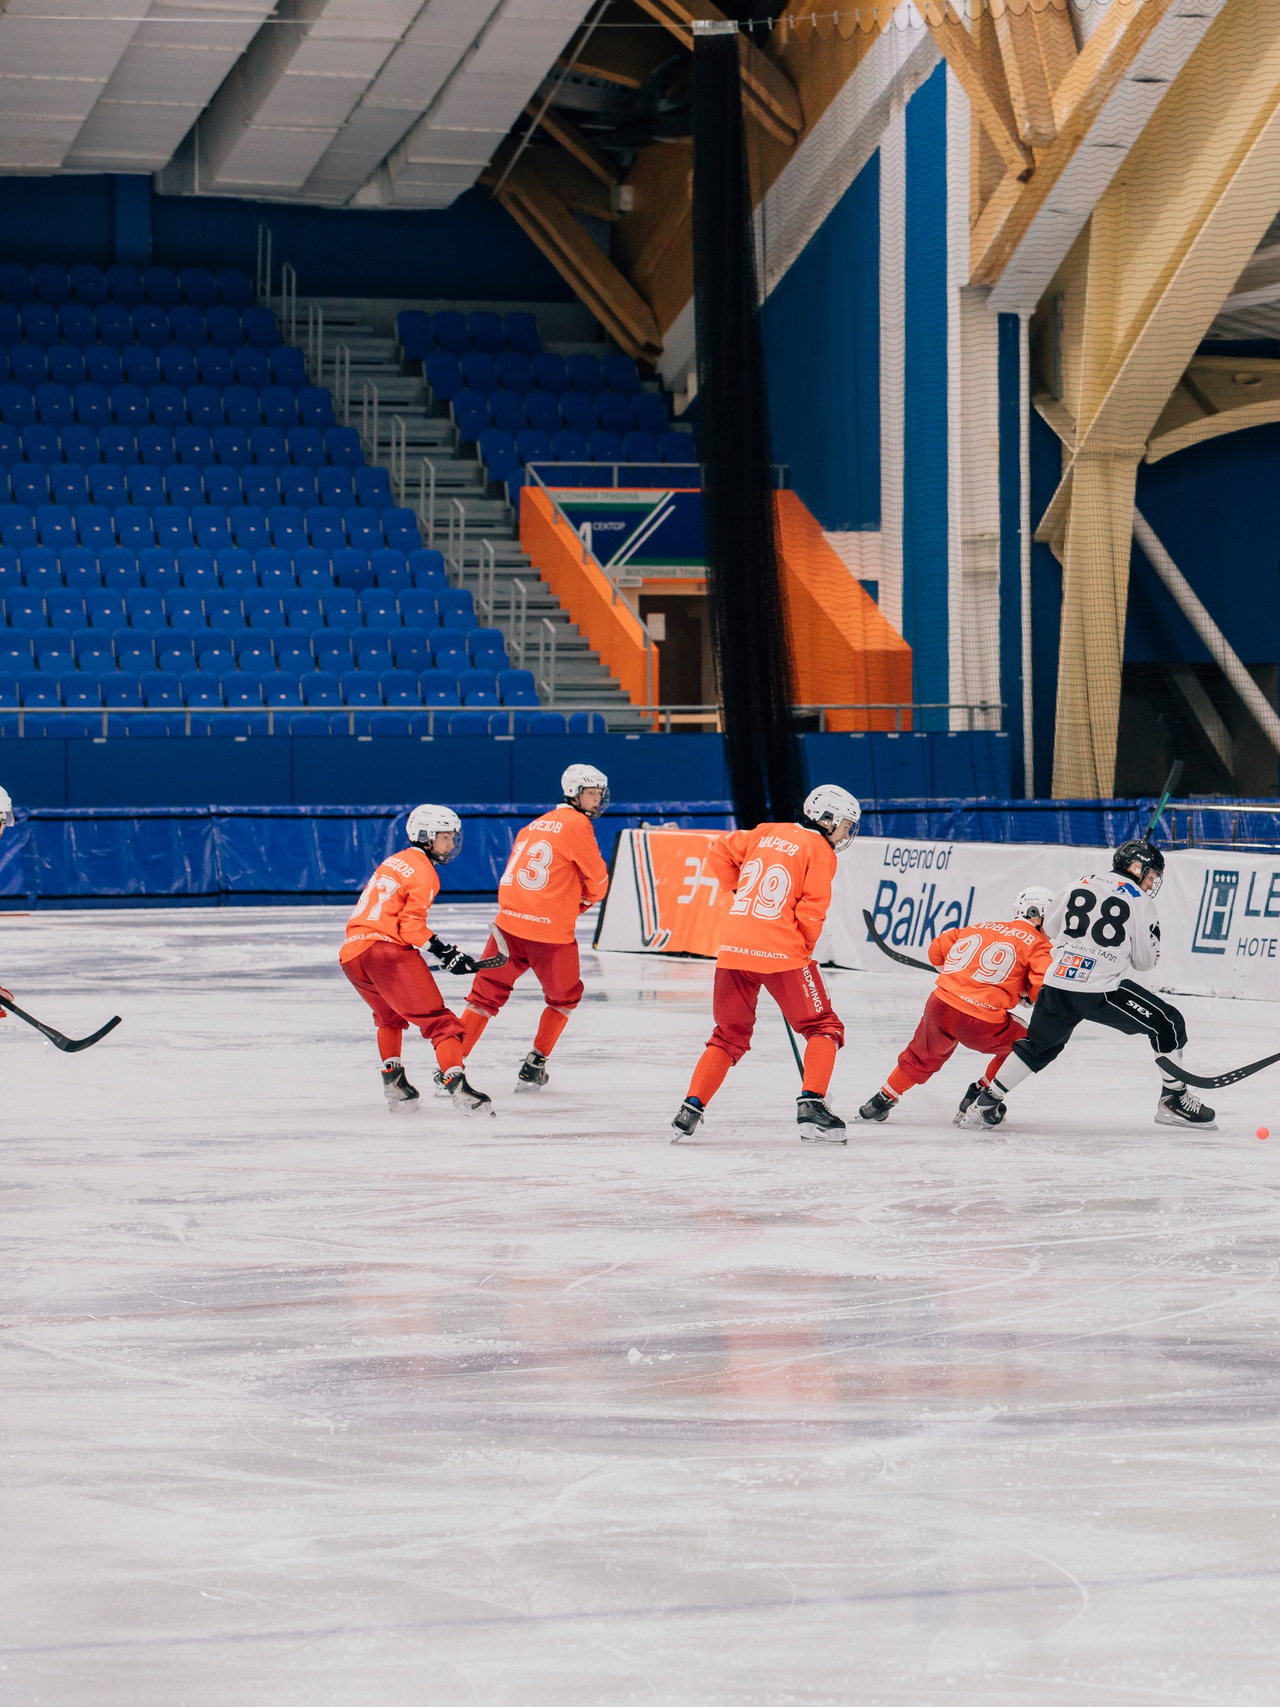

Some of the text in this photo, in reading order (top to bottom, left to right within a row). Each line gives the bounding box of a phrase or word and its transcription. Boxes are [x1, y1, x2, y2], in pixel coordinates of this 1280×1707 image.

[593, 521, 626, 531] СЕКТОР
[500, 837, 553, 891] 13
[883, 843, 954, 874] Legend of
[729, 857, 792, 920] 29
[866, 879, 976, 947] Baikal
[1063, 888, 1131, 948] 88
[445, 952, 465, 971] CCM
[750, 949, 789, 960] ОБЛАСТЬ
[940, 934, 1017, 985] 99
[1236, 937, 1278, 958] HOTE
[1126, 999, 1153, 1019] STEX
